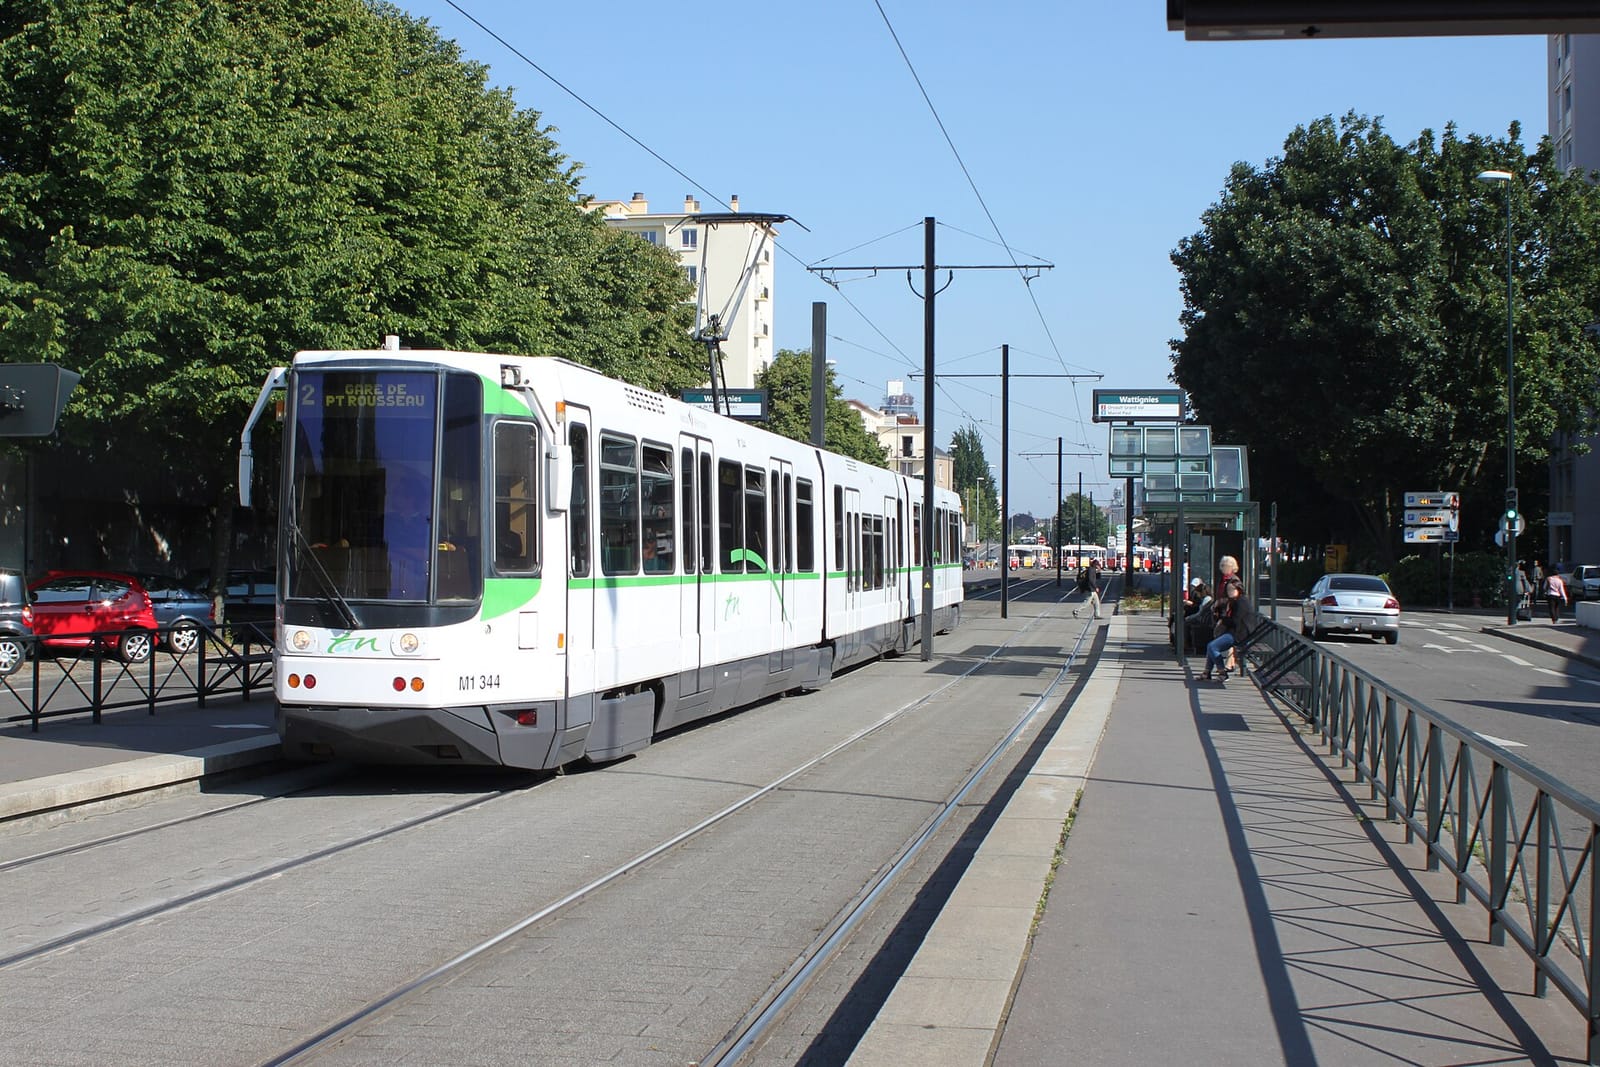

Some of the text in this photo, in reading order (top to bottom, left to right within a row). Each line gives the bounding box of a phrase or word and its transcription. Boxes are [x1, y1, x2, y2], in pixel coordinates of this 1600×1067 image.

[301, 383, 315, 405] 2
[345, 383, 407, 395] GARE DE
[325, 395, 425, 407] PT ROUSSEAU
[1119, 395, 1159, 404] Wattignies
[479, 674, 501, 690] 344
